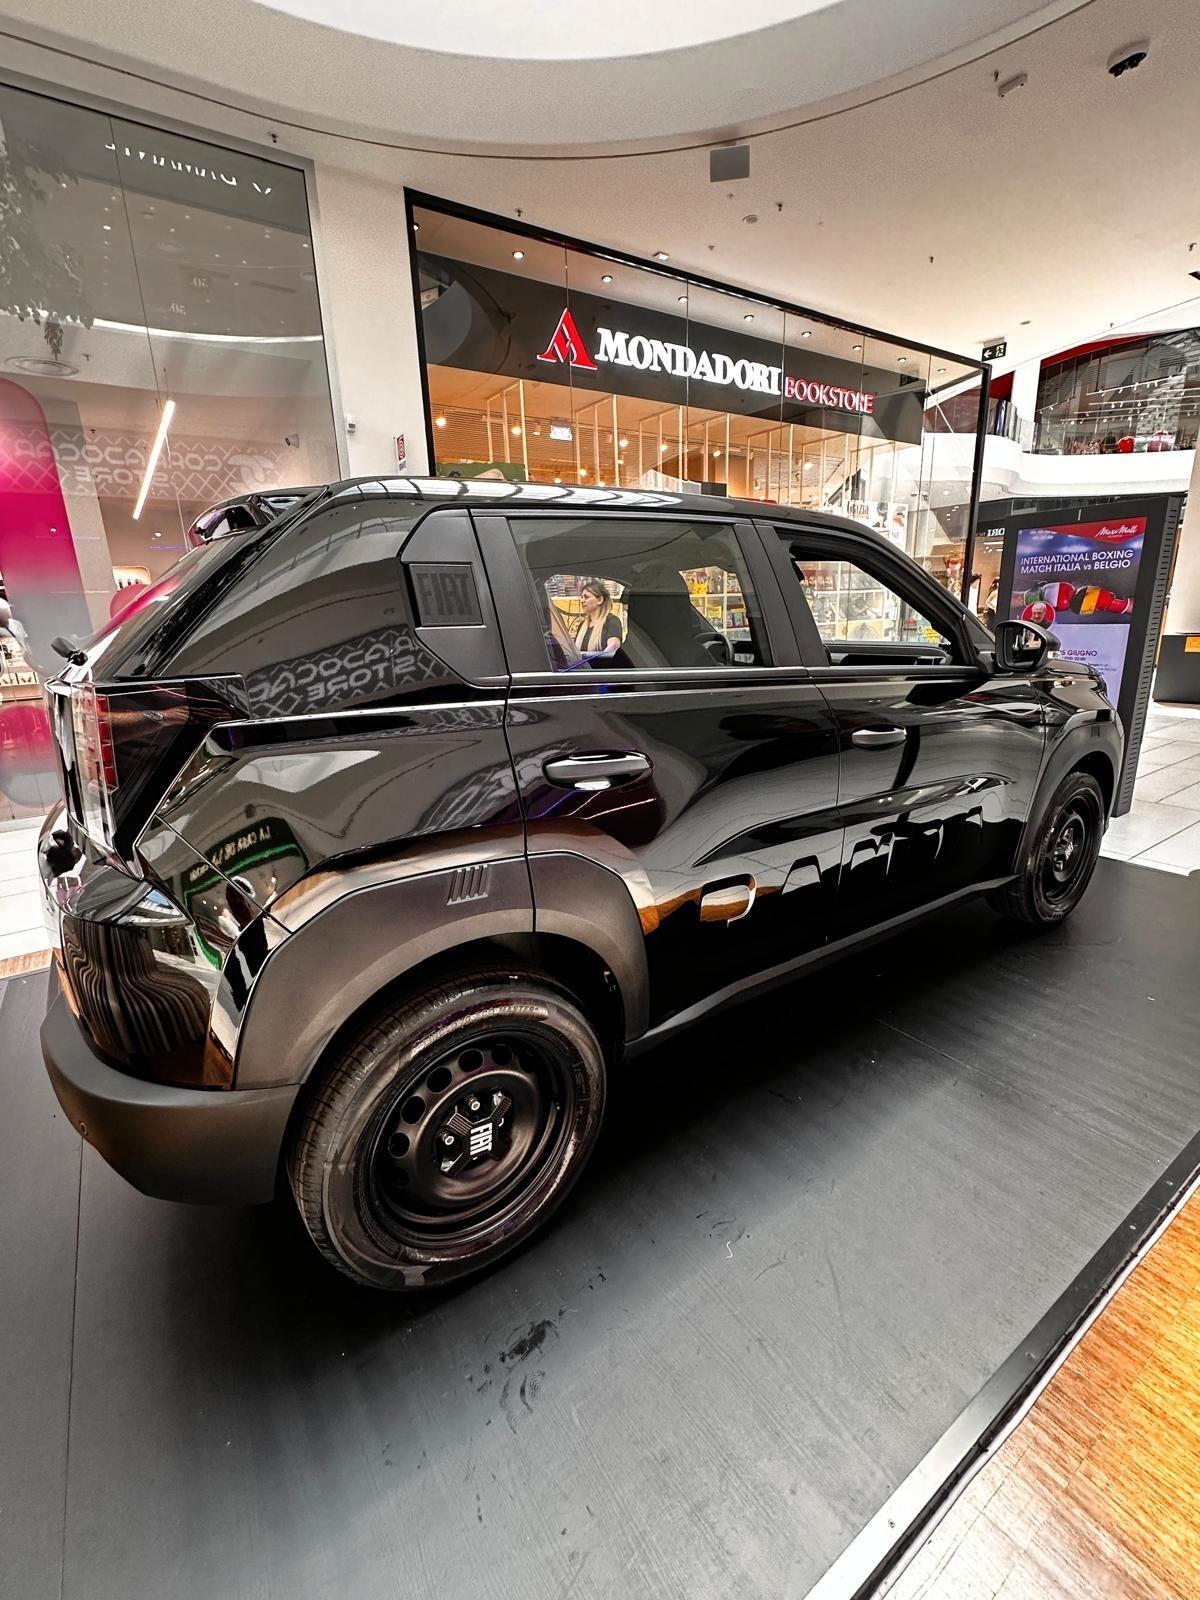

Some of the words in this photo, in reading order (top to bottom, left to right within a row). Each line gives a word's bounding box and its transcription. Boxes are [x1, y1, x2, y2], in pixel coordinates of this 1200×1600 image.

[594, 327, 782, 396] MONDADORI
[784, 376, 874, 414] BOOKSTORE
[1020, 564, 1052, 574] MATCH
[1054, 562, 1081, 572] ITALIA
[1094, 559, 1131, 570] BELGIO
[1021, 553, 1090, 565] INTERNATIONAL
[1092, 549, 1133, 561] BOXING
[416, 573, 472, 616] FIAT
[470, 1122, 493, 1156] FIAT
